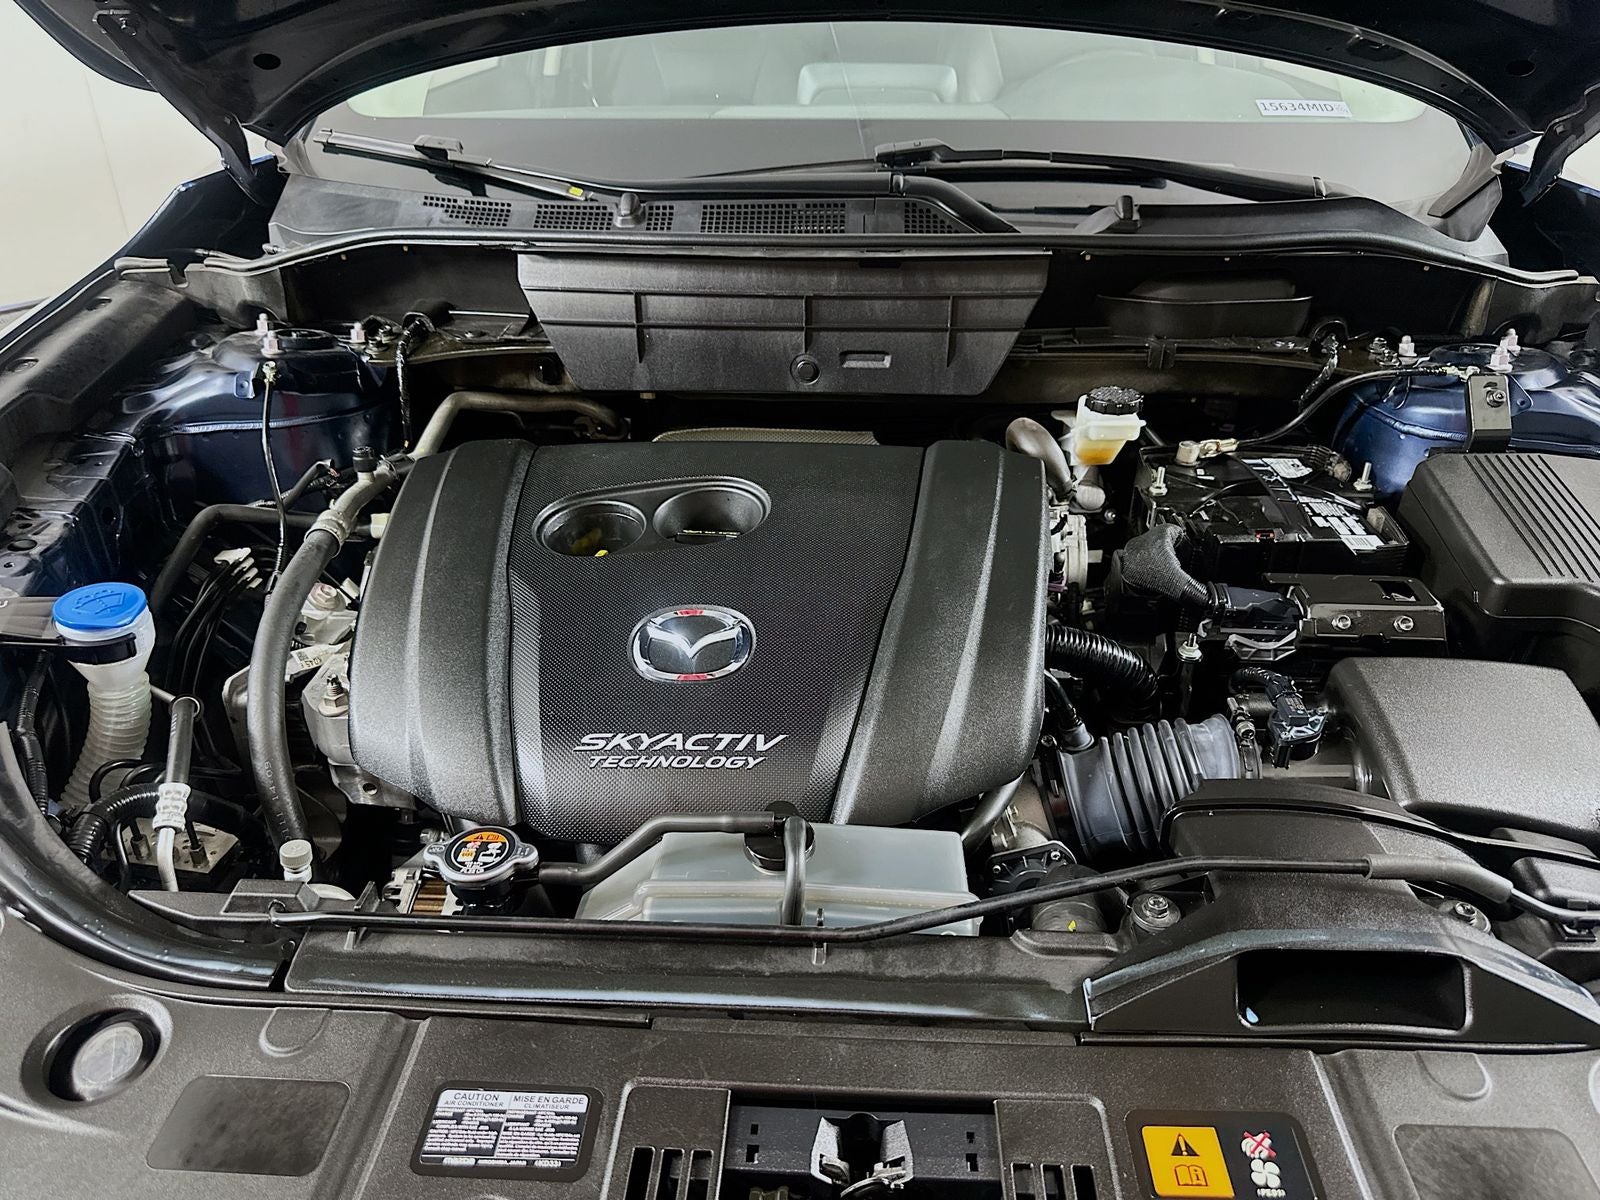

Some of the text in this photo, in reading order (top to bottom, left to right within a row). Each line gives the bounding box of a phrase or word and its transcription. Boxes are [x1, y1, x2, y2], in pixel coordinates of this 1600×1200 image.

[1260, 102, 1334, 112] 15634MID
[573, 733, 788, 751] SKYACTIV
[589, 755, 766, 769] TECHNOLOGY
[453, 1092, 500, 1101] CAUTION
[513, 1095, 536, 1103] MISE
[552, 1096, 585, 1105] GARDE
[457, 1100, 504, 1108] CONDITIONER
